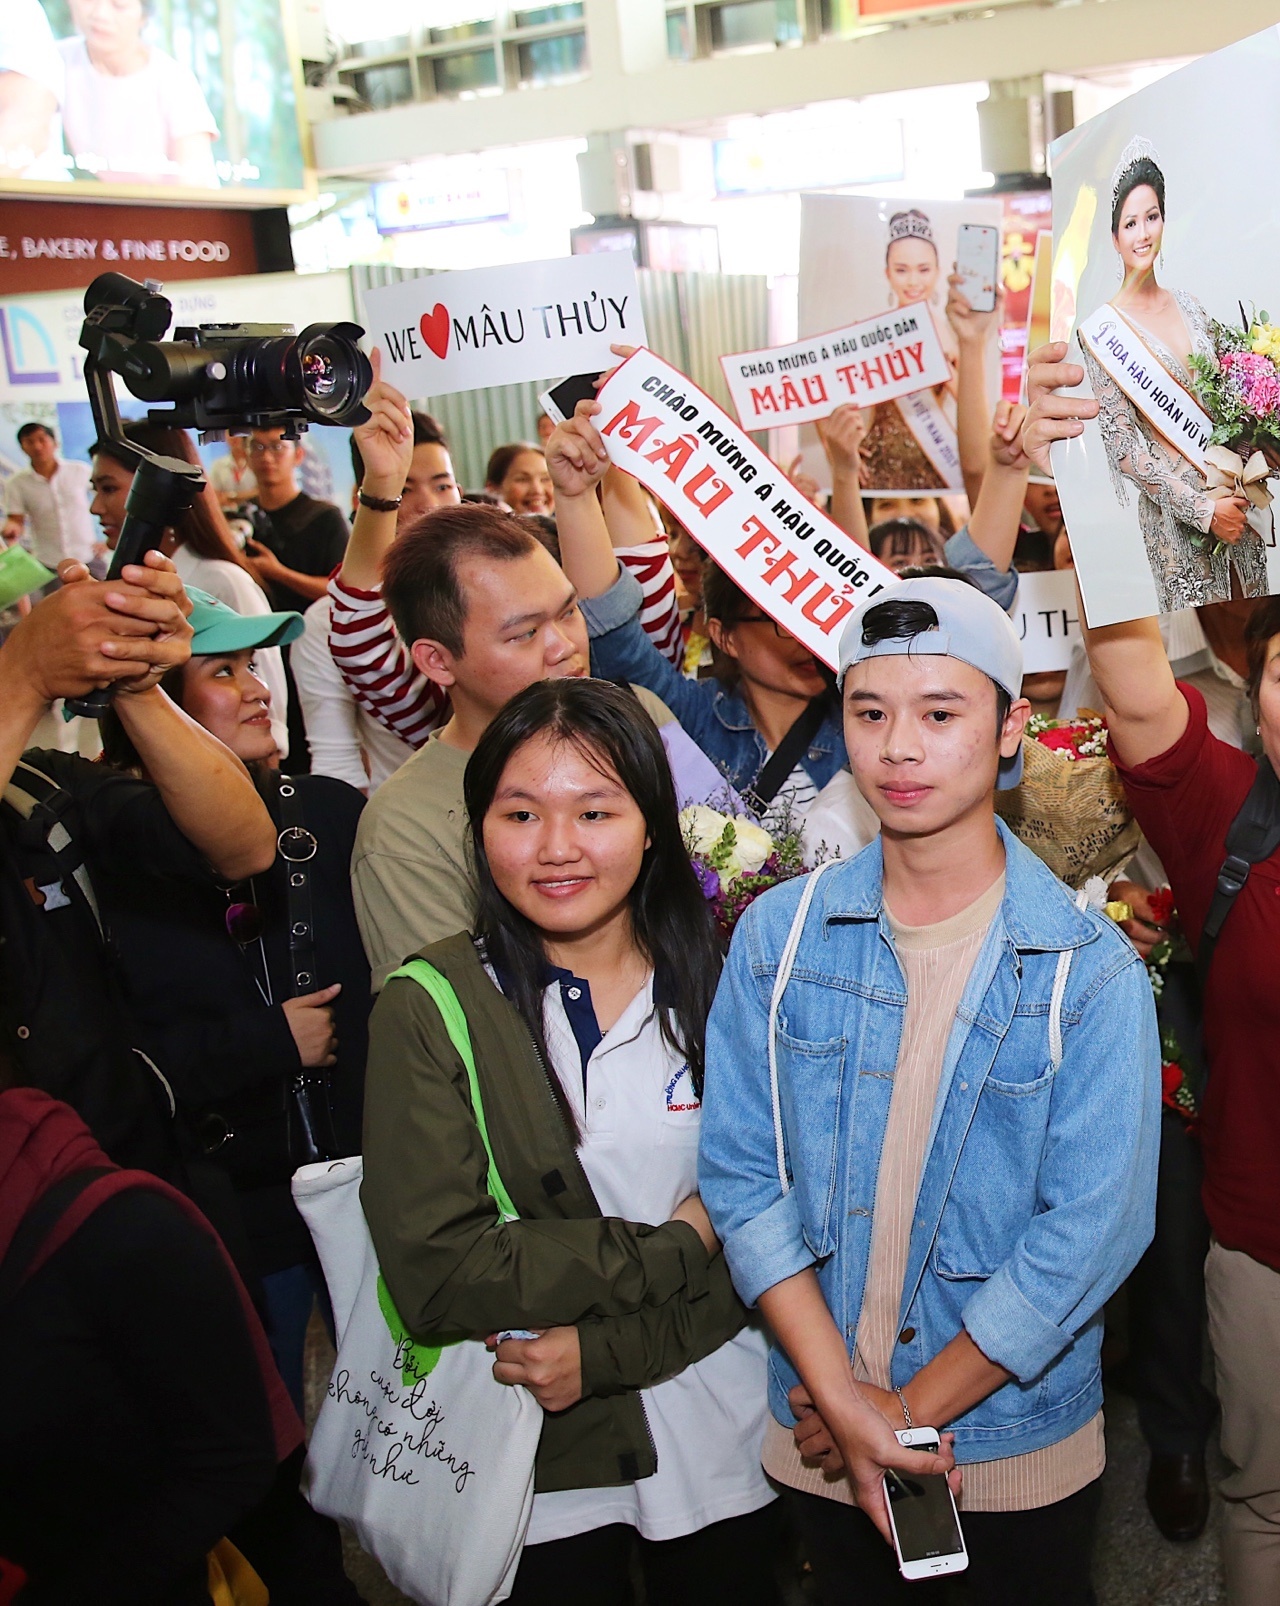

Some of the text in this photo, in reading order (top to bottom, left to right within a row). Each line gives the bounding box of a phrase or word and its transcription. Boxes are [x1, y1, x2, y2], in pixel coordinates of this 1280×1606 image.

[21, 236, 98, 260] BAKERY
[102, 239, 120, 261] &
[120, 239, 167, 262] FINE
[167, 239, 231, 262] FOOD
[384, 290, 628, 364] WE MÂU THỦY
[740, 362, 774, 379] CHÀO
[777, 348, 817, 372] MỪNG
[833, 338, 858, 358] HẬU
[862, 325, 893, 348] QUỐC
[894, 317, 919, 338] DÂN
[749, 341, 926, 416] MÂU THỦY
[1106, 335, 1129, 366] HOA
[1126, 360, 1153, 391] HẬU
[1149, 386, 1184, 424] HOÀN
[1182, 417, 1201, 440] VŨ
[600, 399, 734, 520] MÂU
[641, 375, 871, 589] CHÀO MỪNG Á HẬU QUỐC
